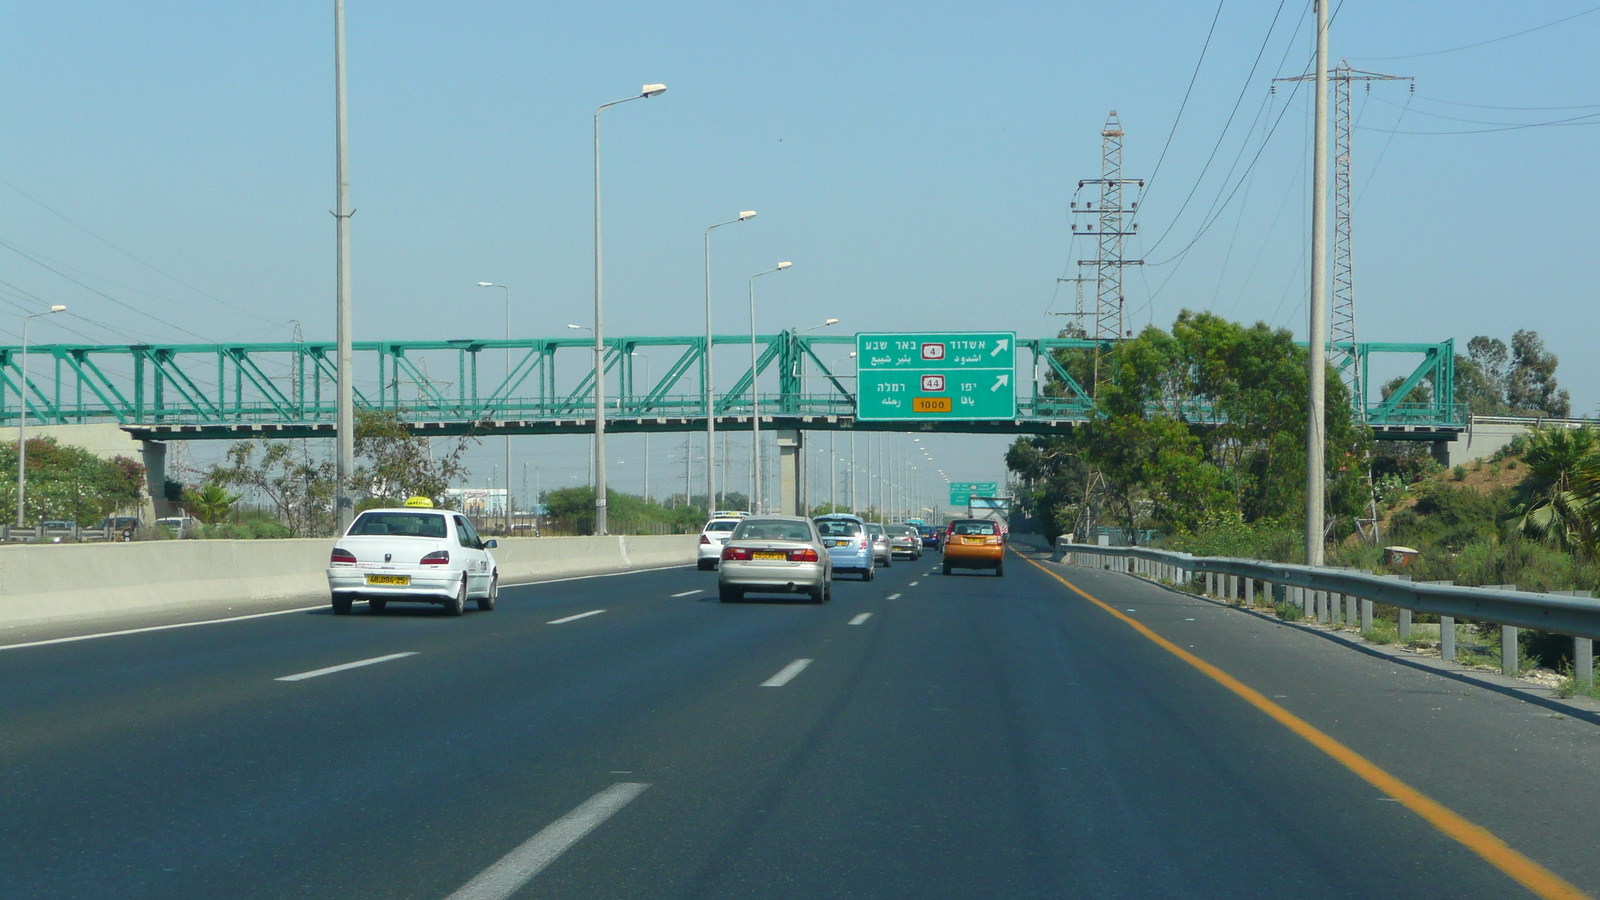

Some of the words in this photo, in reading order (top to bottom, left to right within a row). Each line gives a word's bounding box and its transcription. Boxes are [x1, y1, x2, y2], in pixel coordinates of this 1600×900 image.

[865, 341, 888, 350] שבע
[895, 341, 917, 350] באר
[949, 340, 986, 350] אשדוד
[877, 382, 906, 392] רמלה
[926, 379, 940, 388] 44
[960, 382, 977, 392] יפו
[920, 401, 945, 409] 1000
